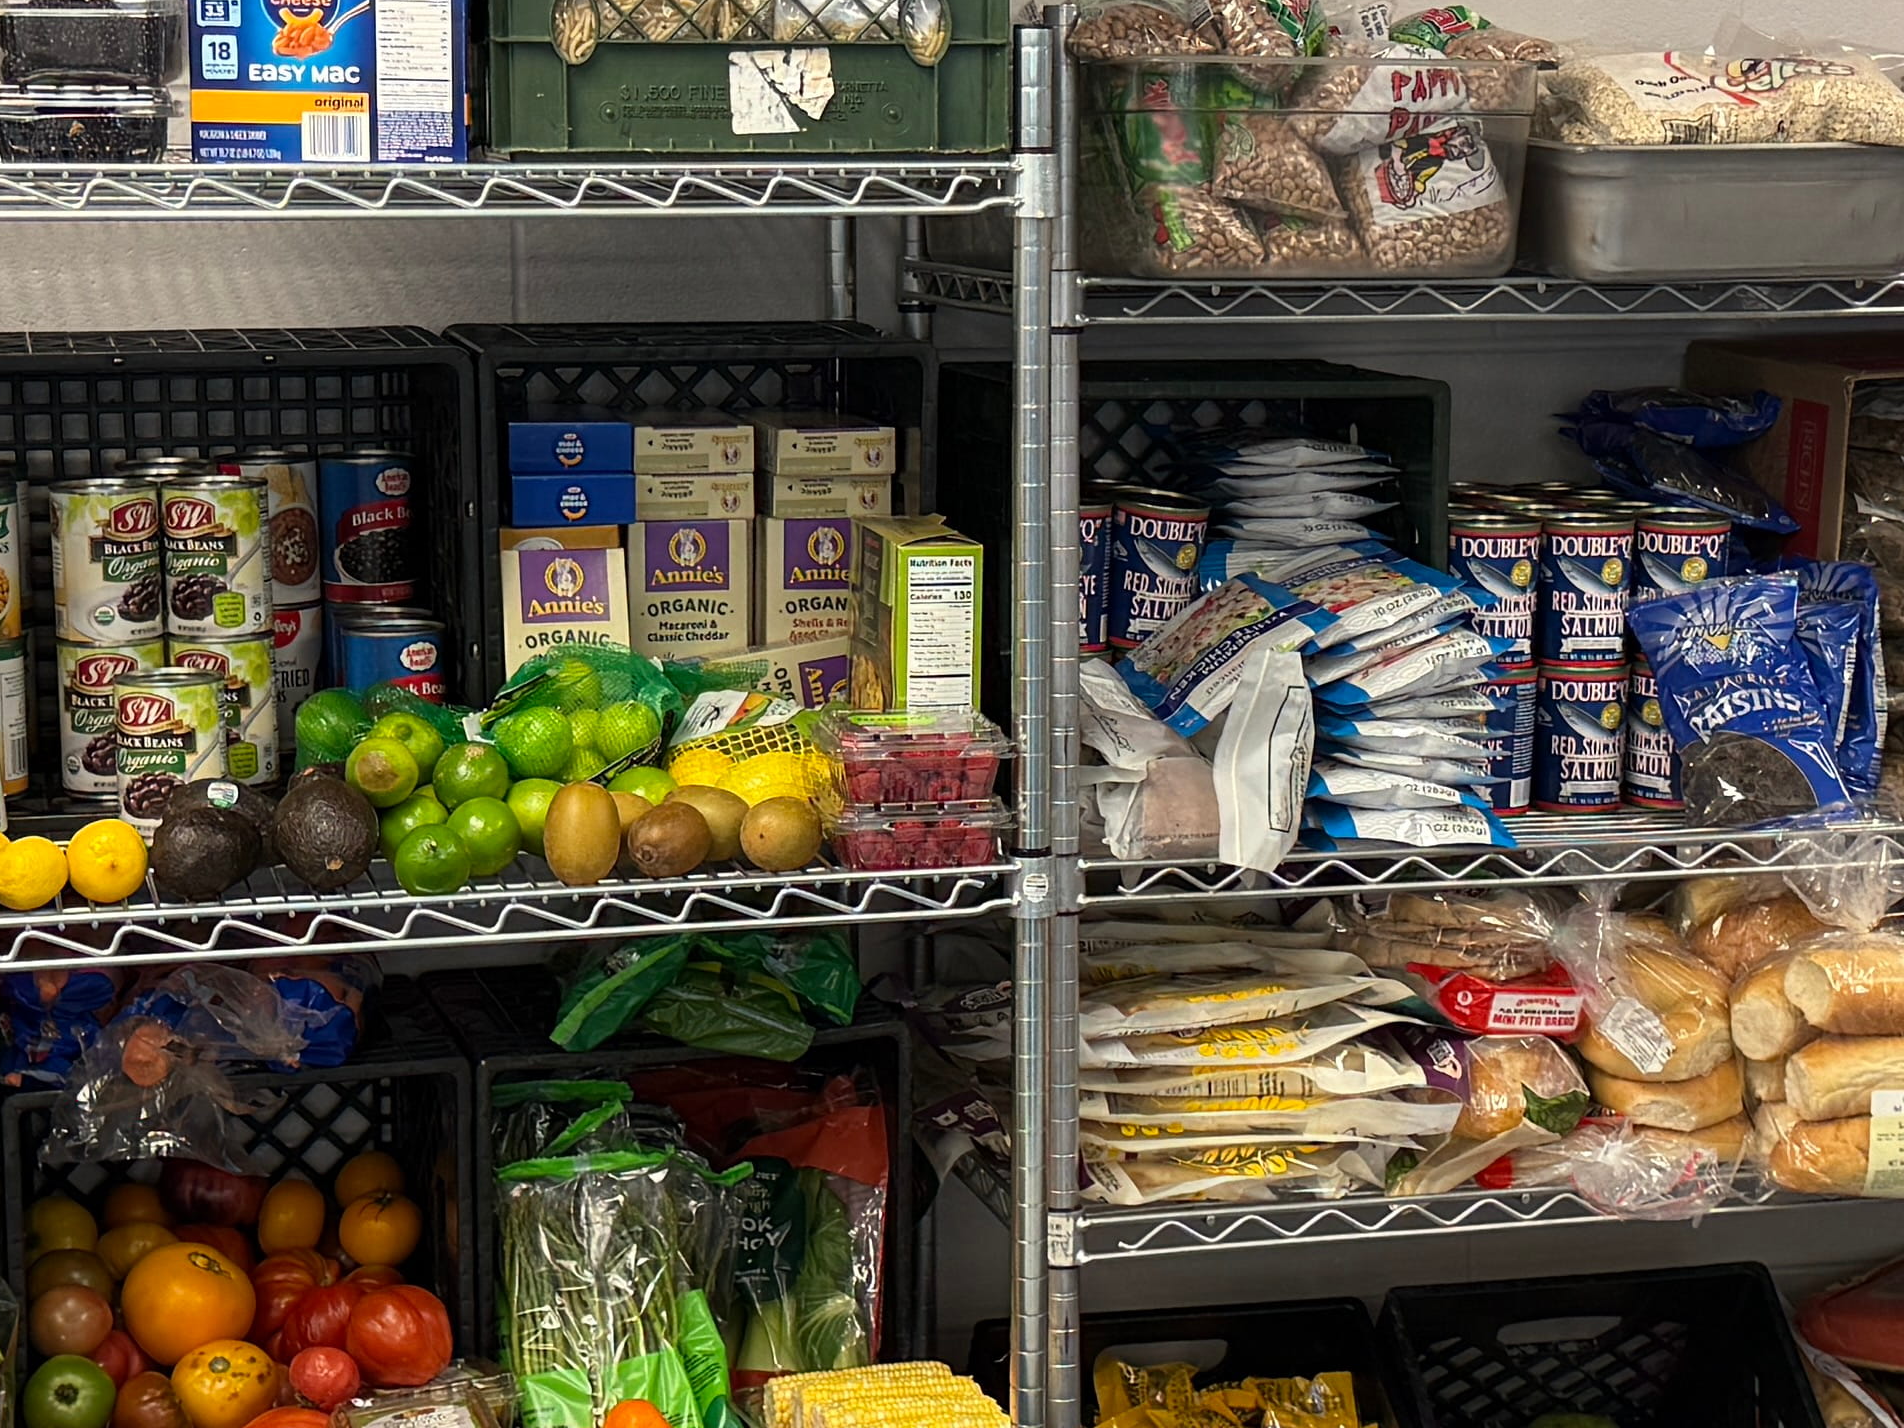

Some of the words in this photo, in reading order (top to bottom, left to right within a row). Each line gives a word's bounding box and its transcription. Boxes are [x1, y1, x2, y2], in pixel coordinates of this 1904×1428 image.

[205, 5, 225, 17] 3.5
[208, 42, 231, 61] 18
[688, 85, 728, 101] FINE
[314, 96, 363, 110] original
[352, 508, 394, 526] Black
[1130, 516, 1195, 542] DOUBLE
[104, 544, 141, 555] BLACK
[187, 540, 224, 551] BEANS
[1462, 538, 1526, 558] DOUBLE
[1553, 537, 1618, 557] DOUBLE
[1638, 533, 1700, 556] DOUBLE
[651, 566, 724, 585] Annie's
[1124, 570, 1148, 593] RED
[954, 591, 972, 600] 130
[1553, 591, 1578, 611] RED
[528, 596, 604, 618] Annie's
[648, 598, 728, 617] ORGANIC
[659, 621, 706, 630] Macaroni
[793, 618, 823, 628] Shells
[525, 630, 610, 649] ORGANIC
[647, 633, 684, 642] Classic
[686, 632, 729, 641] Cheddar
[1170, 641, 1233, 701] CHICKEN
[72, 695, 107, 707] BLACK
[1552, 682, 1617, 702] DOUBLE
[146, 738, 183, 748] BEANS
[1551, 736, 1577, 755] RED
[118, 748, 178, 772] Organic
[1493, 1015, 1516, 1026] MINI
[1519, 1015, 1542, 1026] PITA
[1545, 1016, 1575, 1027] BREAD
